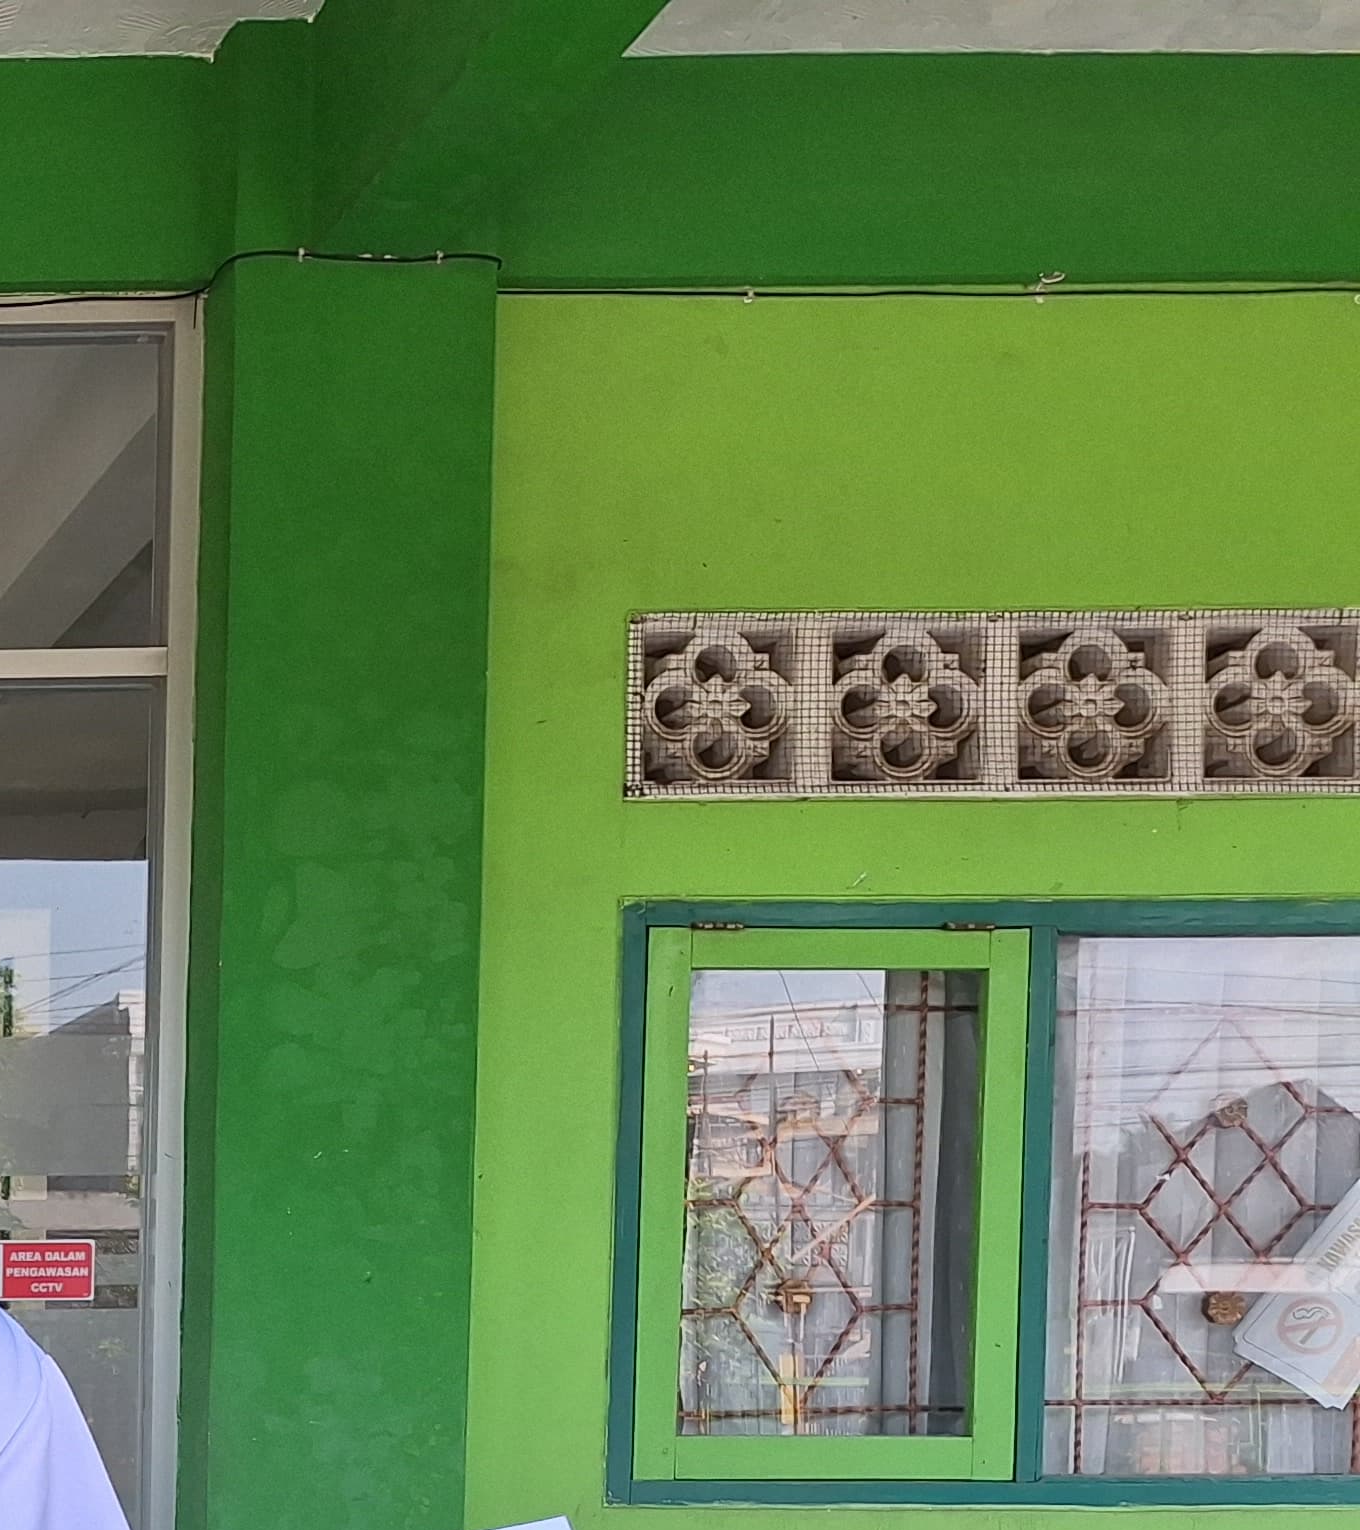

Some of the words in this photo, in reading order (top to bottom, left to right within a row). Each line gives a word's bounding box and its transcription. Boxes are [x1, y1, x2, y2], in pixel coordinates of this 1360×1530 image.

[9, 1251, 42, 1262] AREA
[44, 1251, 86, 1262] DALAM
[6, 1267, 89, 1278] PENGAWASAN
[30, 1282, 63, 1293] CCTV
